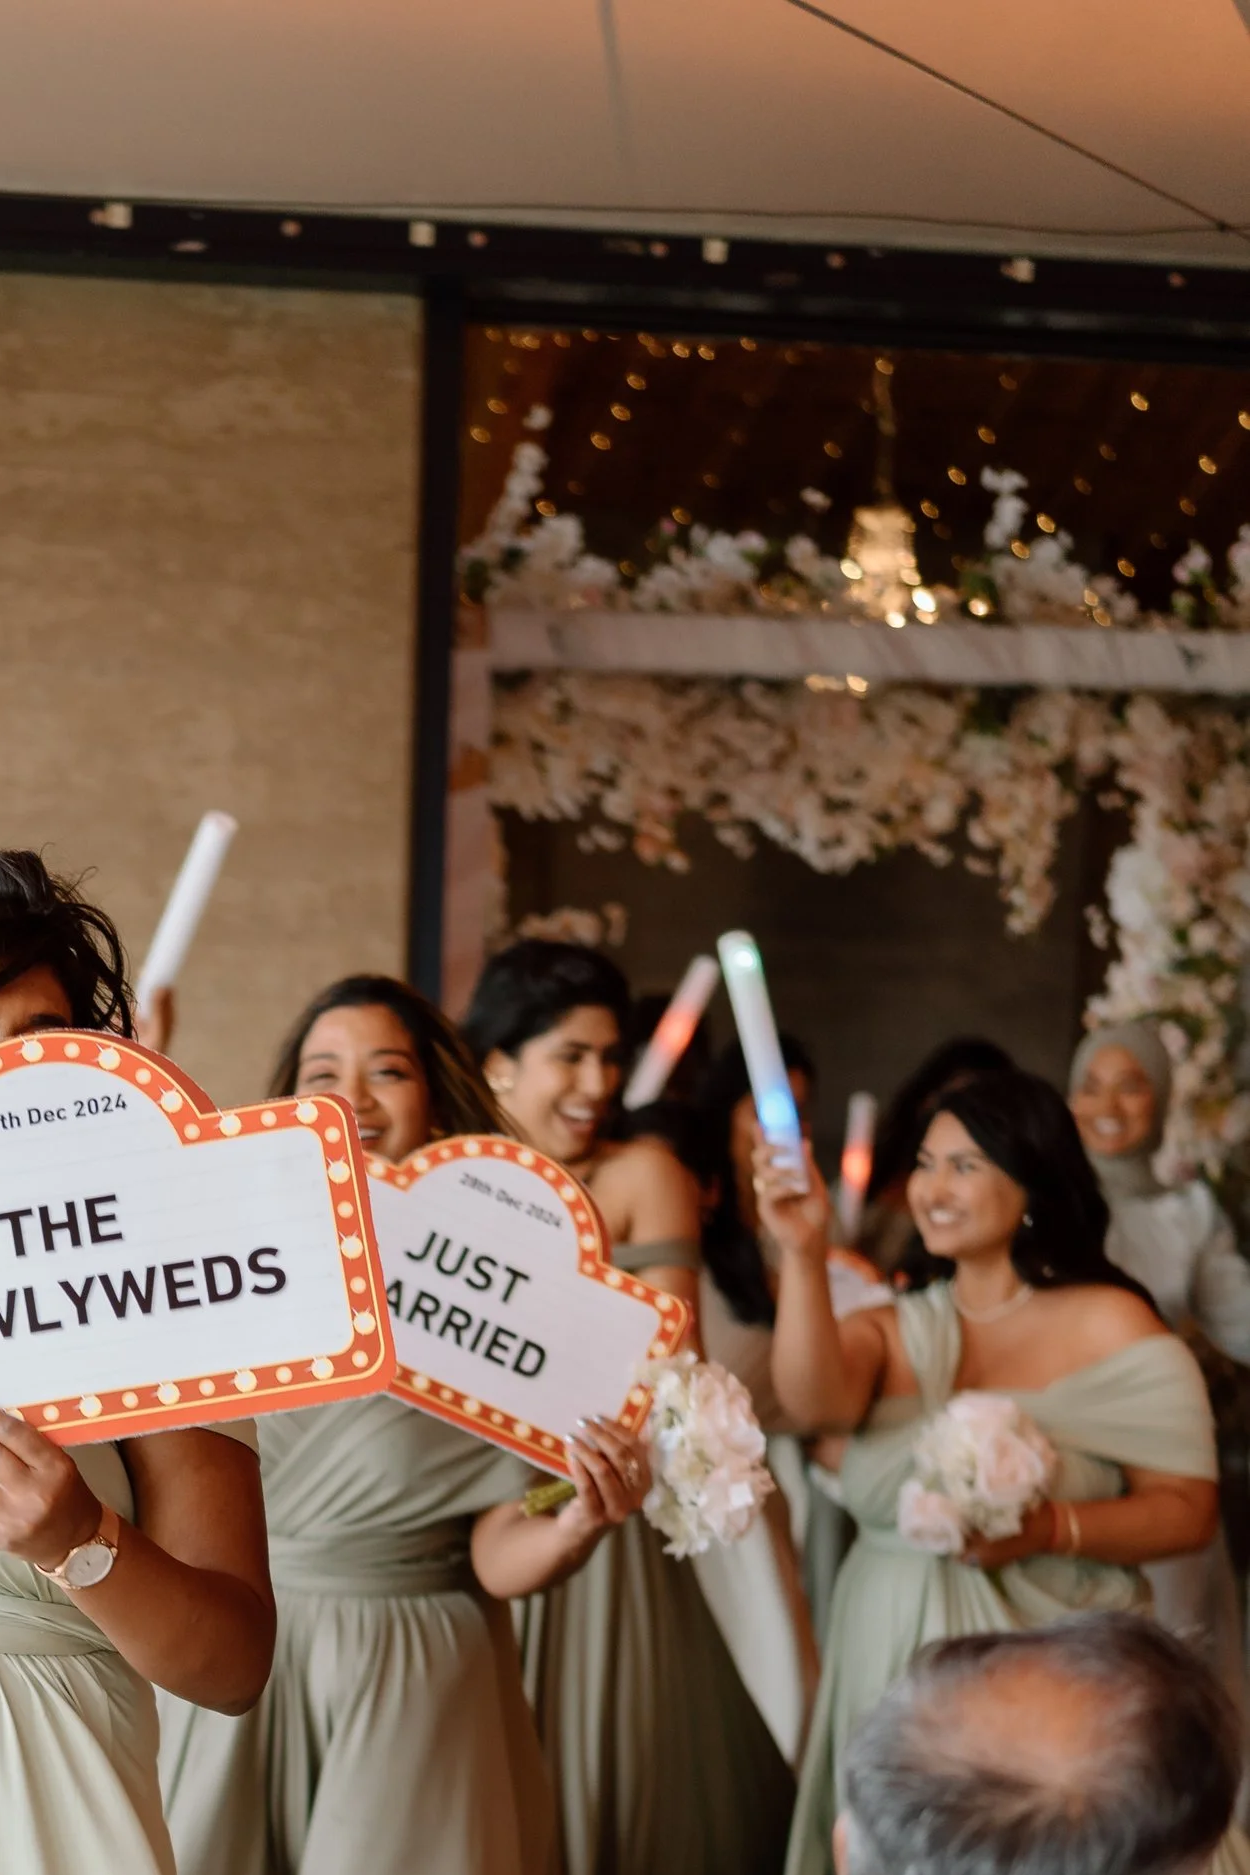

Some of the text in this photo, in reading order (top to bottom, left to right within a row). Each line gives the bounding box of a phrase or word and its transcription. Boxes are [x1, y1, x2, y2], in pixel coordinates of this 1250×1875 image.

[27, 1107, 68, 1126] Dec
[73, 1093, 128, 1117] 2024
[404, 1231, 531, 1304] JUST
[385, 1278, 548, 1379] ARRIED
